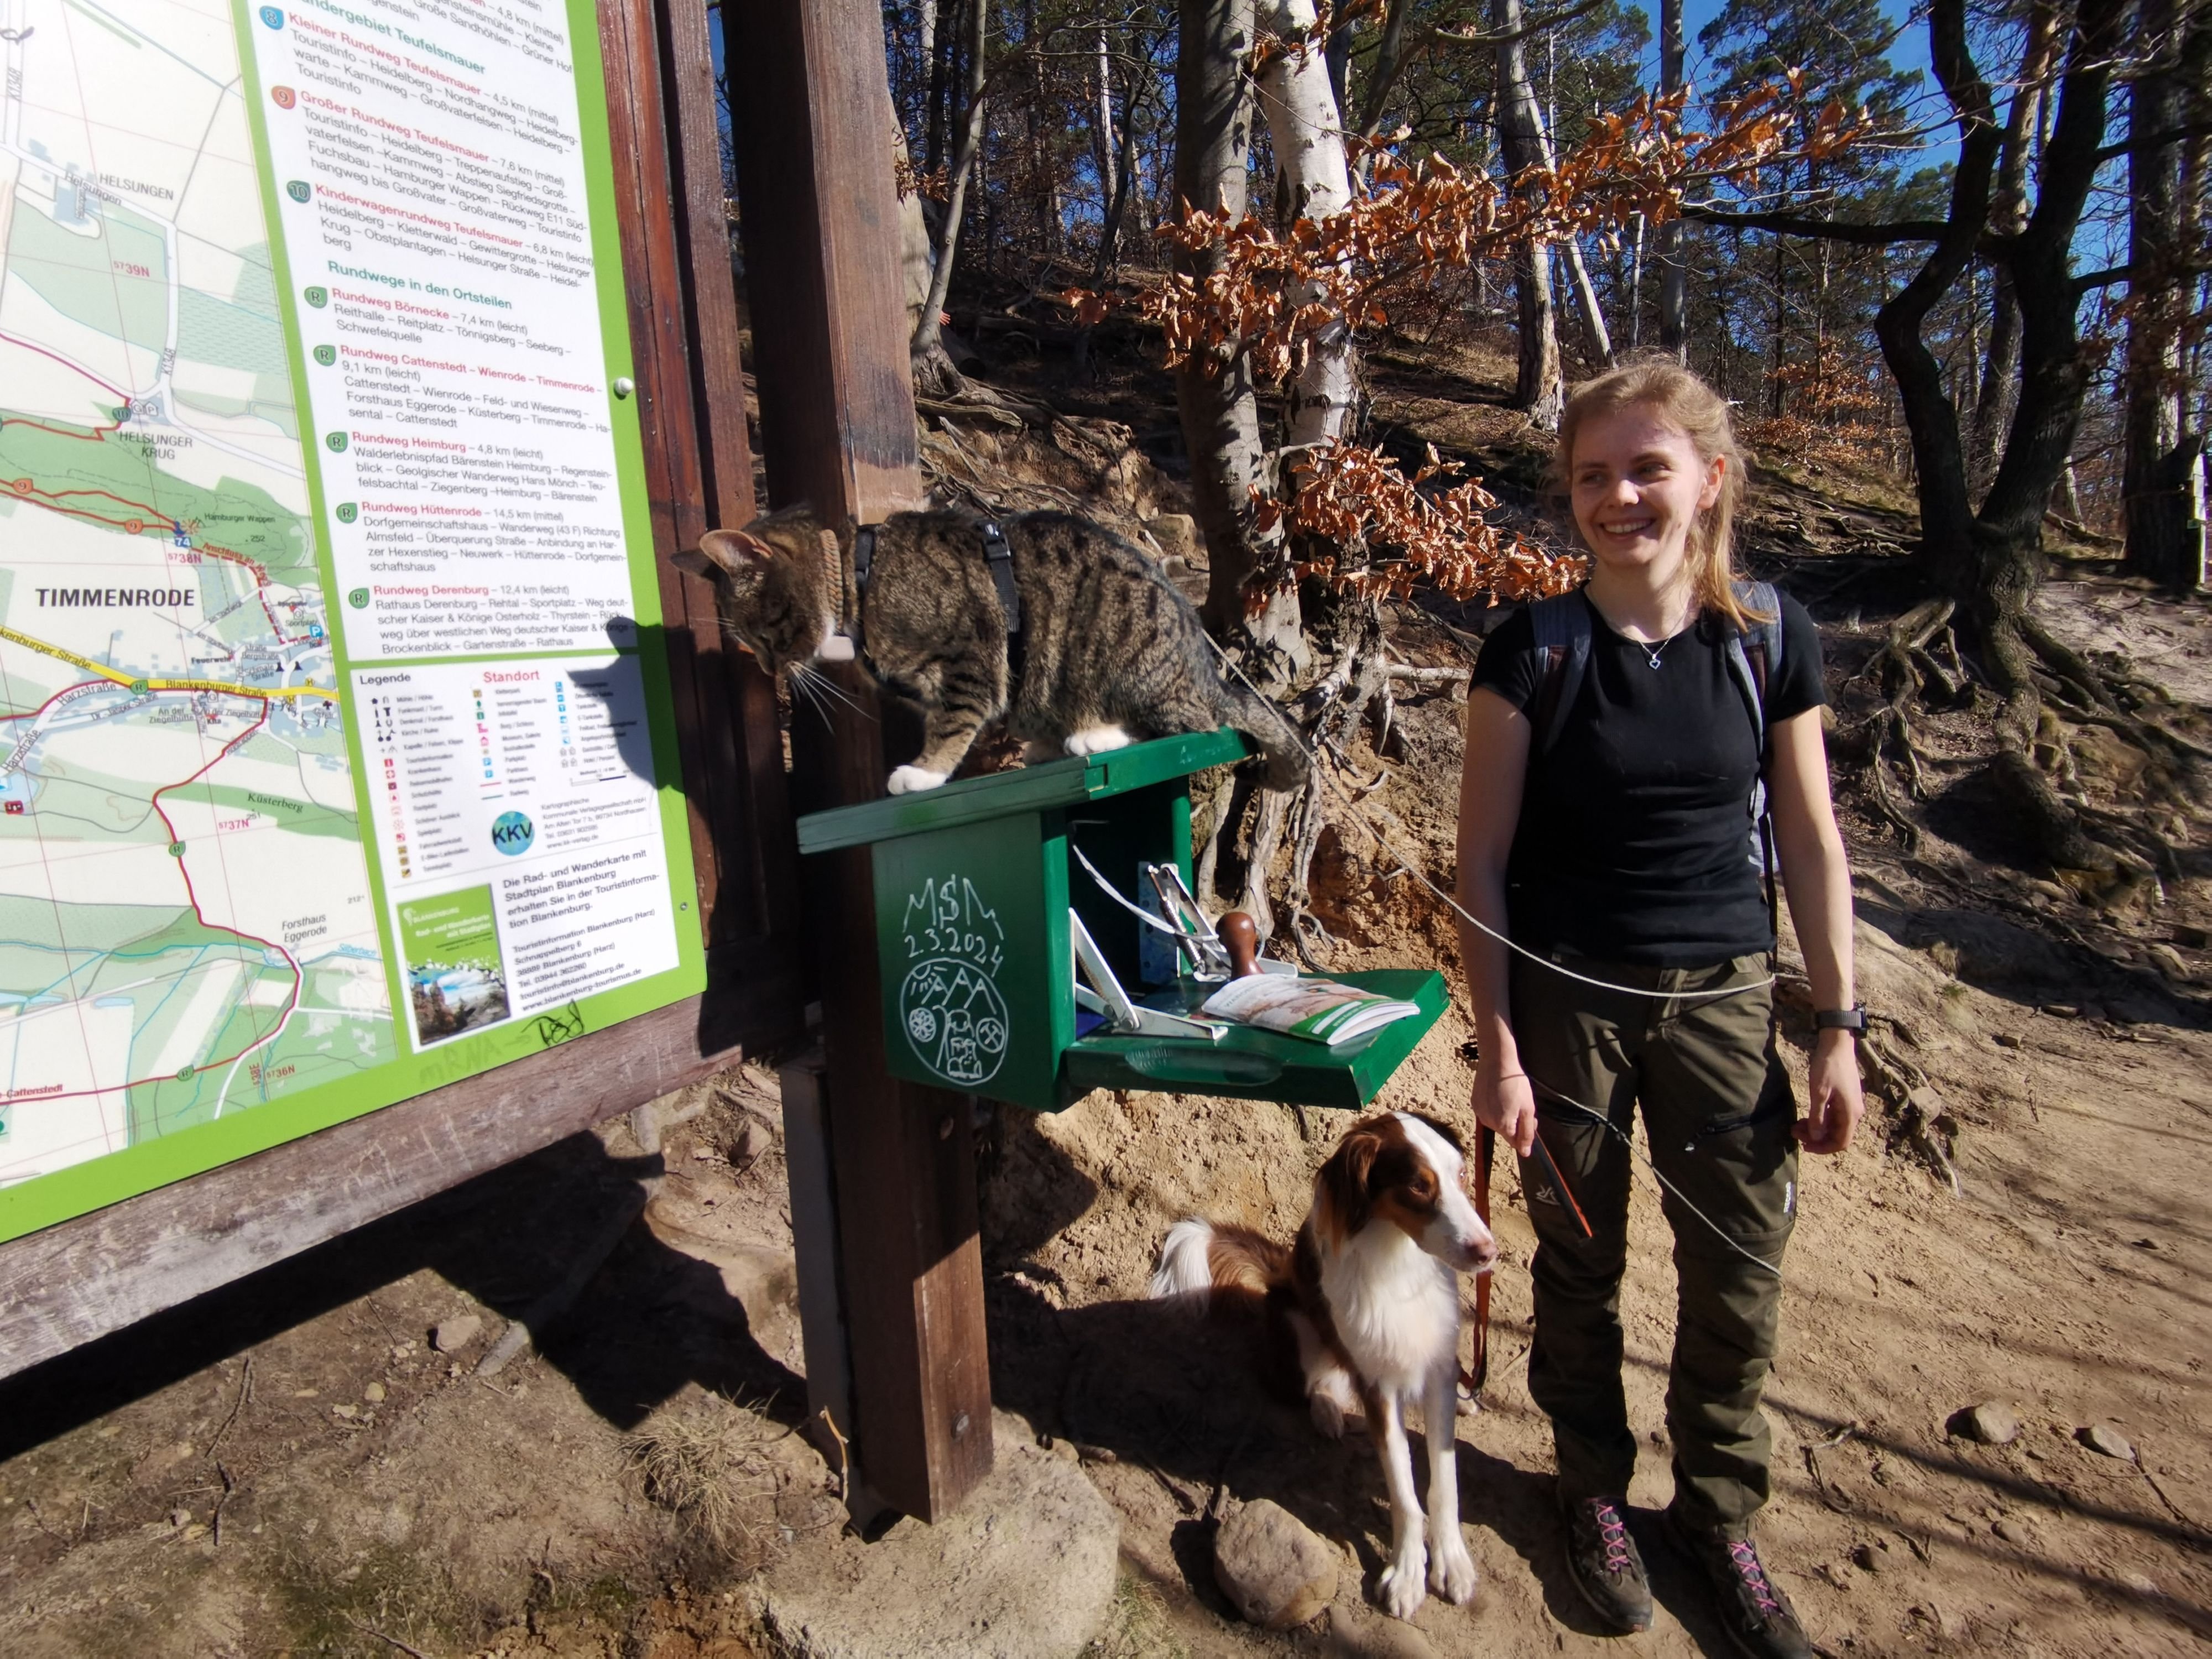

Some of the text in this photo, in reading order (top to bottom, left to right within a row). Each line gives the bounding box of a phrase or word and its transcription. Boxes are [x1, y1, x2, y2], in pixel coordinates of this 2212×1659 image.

[267, 13, 276, 24] 8
[394, 27, 486, 74] Teufelsmauer
[288, 12, 559, 127] Kleiner Rundweg Teufelsmauer 4,5 km (mittel)
[279, 92, 288, 102] 9
[290, 28, 578, 146] Touristinfo Heidelberg Nordhangweg Heidelberg-
[300, 90, 565, 188] Großer Rundweg Teufelsmauer 7,6 km (mittel)
[302, 106, 567, 199] Touristinfo Heidelberg Treppenaufstieg Groß-
[65, 170, 122, 206] Helsungen
[100, 173, 174, 201] HELSUNGEN
[290, 186, 306, 199] 10
[315, 183, 593, 267] Kinderwagenrundweg Teufelsmauer 6,8 km (leicht)
[317, 200, 590, 278] Heidelberg Kletterwald Gewittergrotte Helsunger
[311, 291, 320, 302] R
[327, 259, 512, 310] Rundwege in den Ortsteilen
[331, 287, 528, 336] Rundweg Börnecke 7,4 km (leicht)
[333, 302, 385, 322] Reithalle
[397, 315, 444, 333] Reitplatz
[525, 338, 564, 356] Seeberg
[336, 319, 422, 343] Schwefelquelle
[340, 344, 594, 393] Rundweg Cattenstedt Wienrode Timmenrode
[341, 359, 421, 382] 9,1 km (leicht)
[119, 431, 192, 447] HELSUNGER
[352, 431, 543, 460] Rundweg Heimburg 4,8 km (leicht)
[142, 447, 175, 460] KRUG
[205, 513, 275, 523] Hamburger Wappen
[361, 500, 564, 522] Rundweg Hüttenrode 14,5 km (mittel)
[175, 538, 191, 546] 74
[203, 542, 244, 562] Anschluss
[35, 589, 195, 607] TIMMENRODE
[373, 585, 569, 597] Rundweg Derenburg 12,4 km (leicht)
[56, 650, 91, 670] Straße
[166, 680, 267, 697] Blankenburger Straße
[359, 672, 411, 686] Legende
[483, 670, 540, 683] Standort
[57, 682, 117, 707] Harzstraße
[2, 729, 41, 773] Harzstraße
[248, 792, 304, 813] Küsterberg
[492, 822, 534, 846] KKV
[502, 849, 647, 889] Die Rad- und Wanderkarte mit
[504, 870, 616, 902] Stadtplan Blankenburg
[506, 874, 659, 916] erhalten Sie in der Touristinforma-
[282, 914, 326, 931] Forsthaus
[508, 917, 529, 929] tion
[530, 902, 593, 924] Blankenburg.
[284, 925, 327, 943] Eggerode
